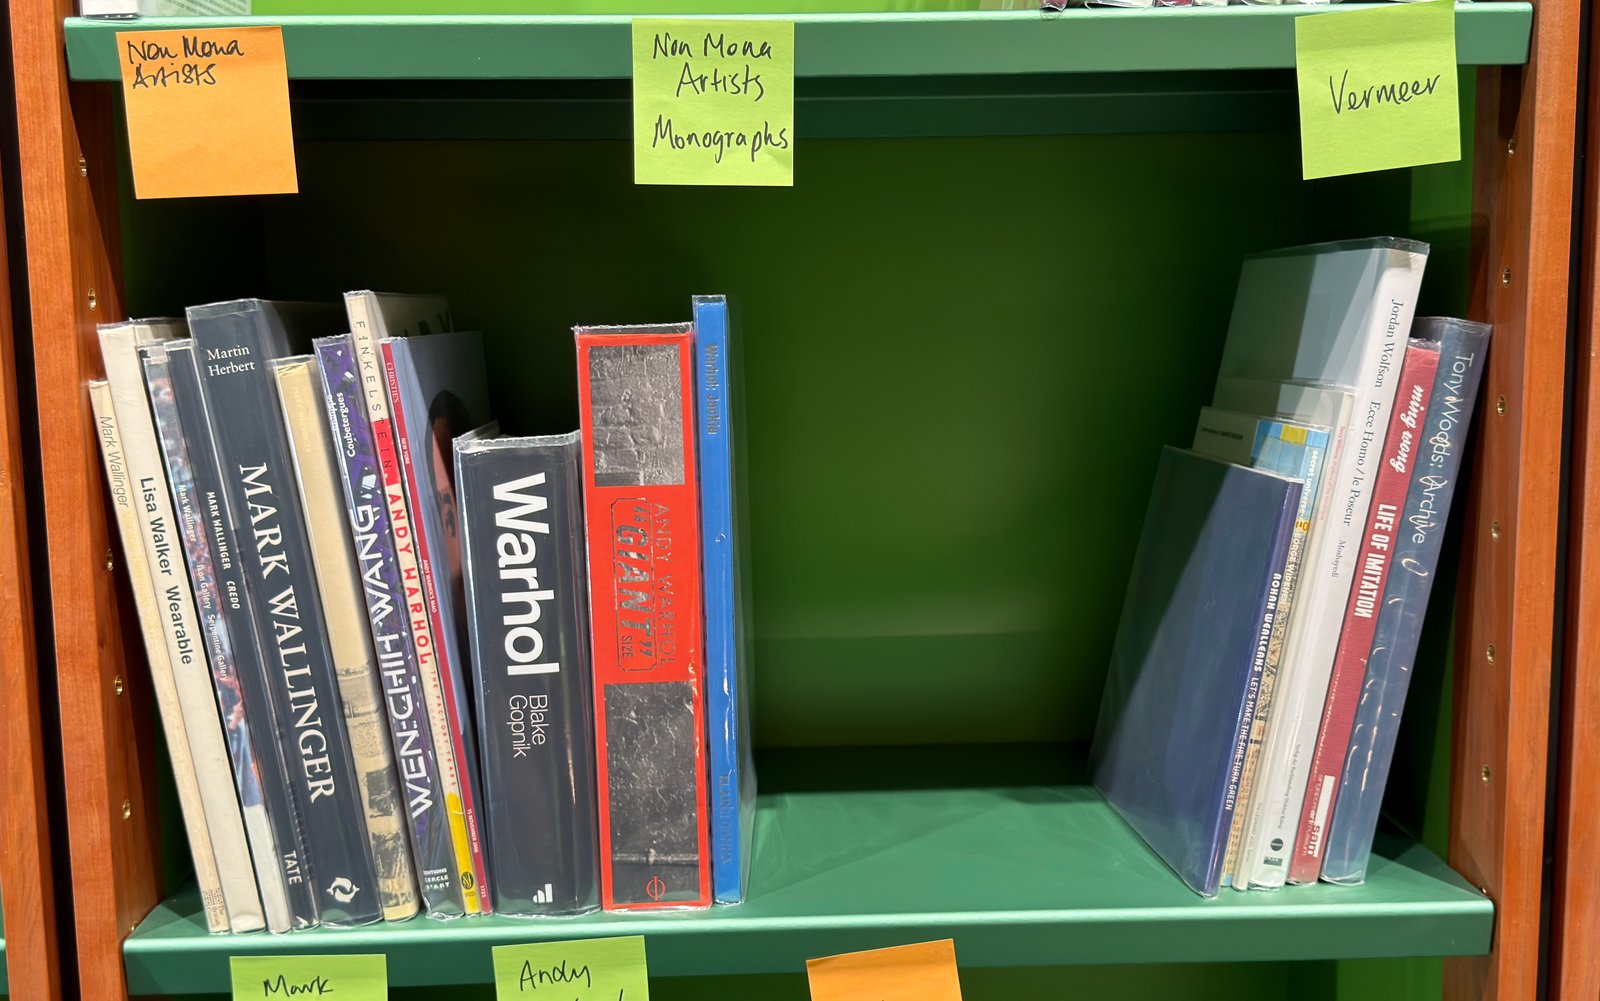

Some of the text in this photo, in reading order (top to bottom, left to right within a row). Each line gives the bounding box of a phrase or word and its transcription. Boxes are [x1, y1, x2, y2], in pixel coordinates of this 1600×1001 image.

[128, 36, 244, 64] Non Mona
[653, 33, 772, 59] Non Mona
[132, 63, 217, 89] Artists
[676, 62, 764, 101] Artists
[1329, 69, 1441, 114] Vermeer
[652, 114, 789, 164] Monographs
[1386, 298, 1404, 338] Jordan
[207, 345, 250, 361] Martin
[208, 360, 255, 377] Herbert
[1374, 341, 1395, 388] Wolfson
[1443, 353, 1475, 395] Tony
[355, 321, 393, 468] FINKELSTEIN
[337, 392, 356, 457] Coubetergues
[1366, 401, 1382, 428] Ecce
[100, 416, 129, 508] Mark Wallinger
[1357, 430, 1375, 467] Homo
[178, 484, 187, 507] Mark
[1351, 475, 1361, 487] le
[182, 507, 197, 542] Wallinger
[1344, 490, 1361, 527] Poseur
[206, 491, 241, 609] MARK WALLINGER CREDO
[350, 504, 394, 624] WANG
[1353, 503, 1397, 619] LIFE OF IMITATION
[140, 477, 193, 665] Lisa Walker Wearable
[388, 493, 412, 554] ANDY
[404, 567, 433, 665] WARHOL
[493, 472, 560, 675] Warhol
[655, 503, 677, 665] ANDY WARHOL
[200, 582, 212, 609] Gallery
[1263, 573, 1282, 610] ROHAN
[207, 614, 221, 654] Serpentine
[239, 462, 336, 804] MARK WALLINGER
[621, 635, 633, 658] SIZE
[1253, 613, 1275, 672] WEALLEANS
[507, 694, 531, 758] Gopnik
[529, 694, 549, 746] Blake
[1243, 700, 1254, 722] MAKE
[1240, 724, 1249, 740] THE
[1224, 783, 1237, 811] GREEN
[283, 851, 302, 885] TATE
[263, 976, 334, 997] Mark
[519, 960, 591, 992] Andy
